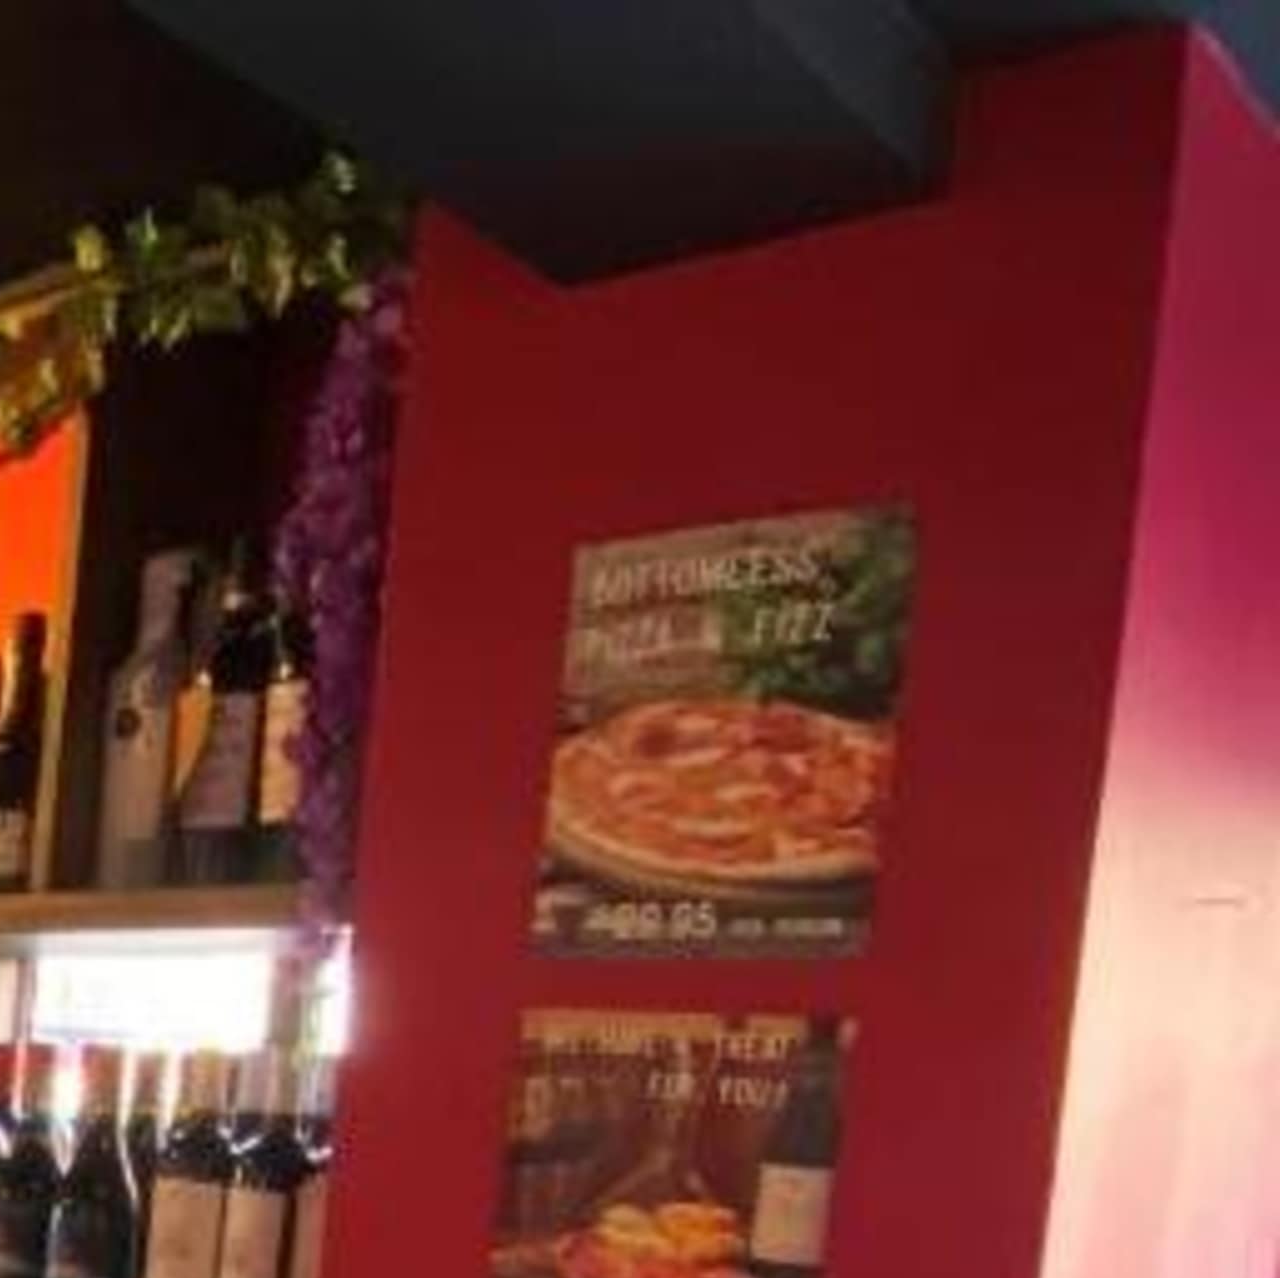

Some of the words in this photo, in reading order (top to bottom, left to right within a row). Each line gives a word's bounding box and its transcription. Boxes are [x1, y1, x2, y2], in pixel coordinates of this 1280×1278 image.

[592, 548, 822, 604] BOTTOMLESS
[752, 602, 832, 647] FIZZ
[714, 1033, 796, 1063] TREAT
[647, 1069, 693, 1103] FOR
